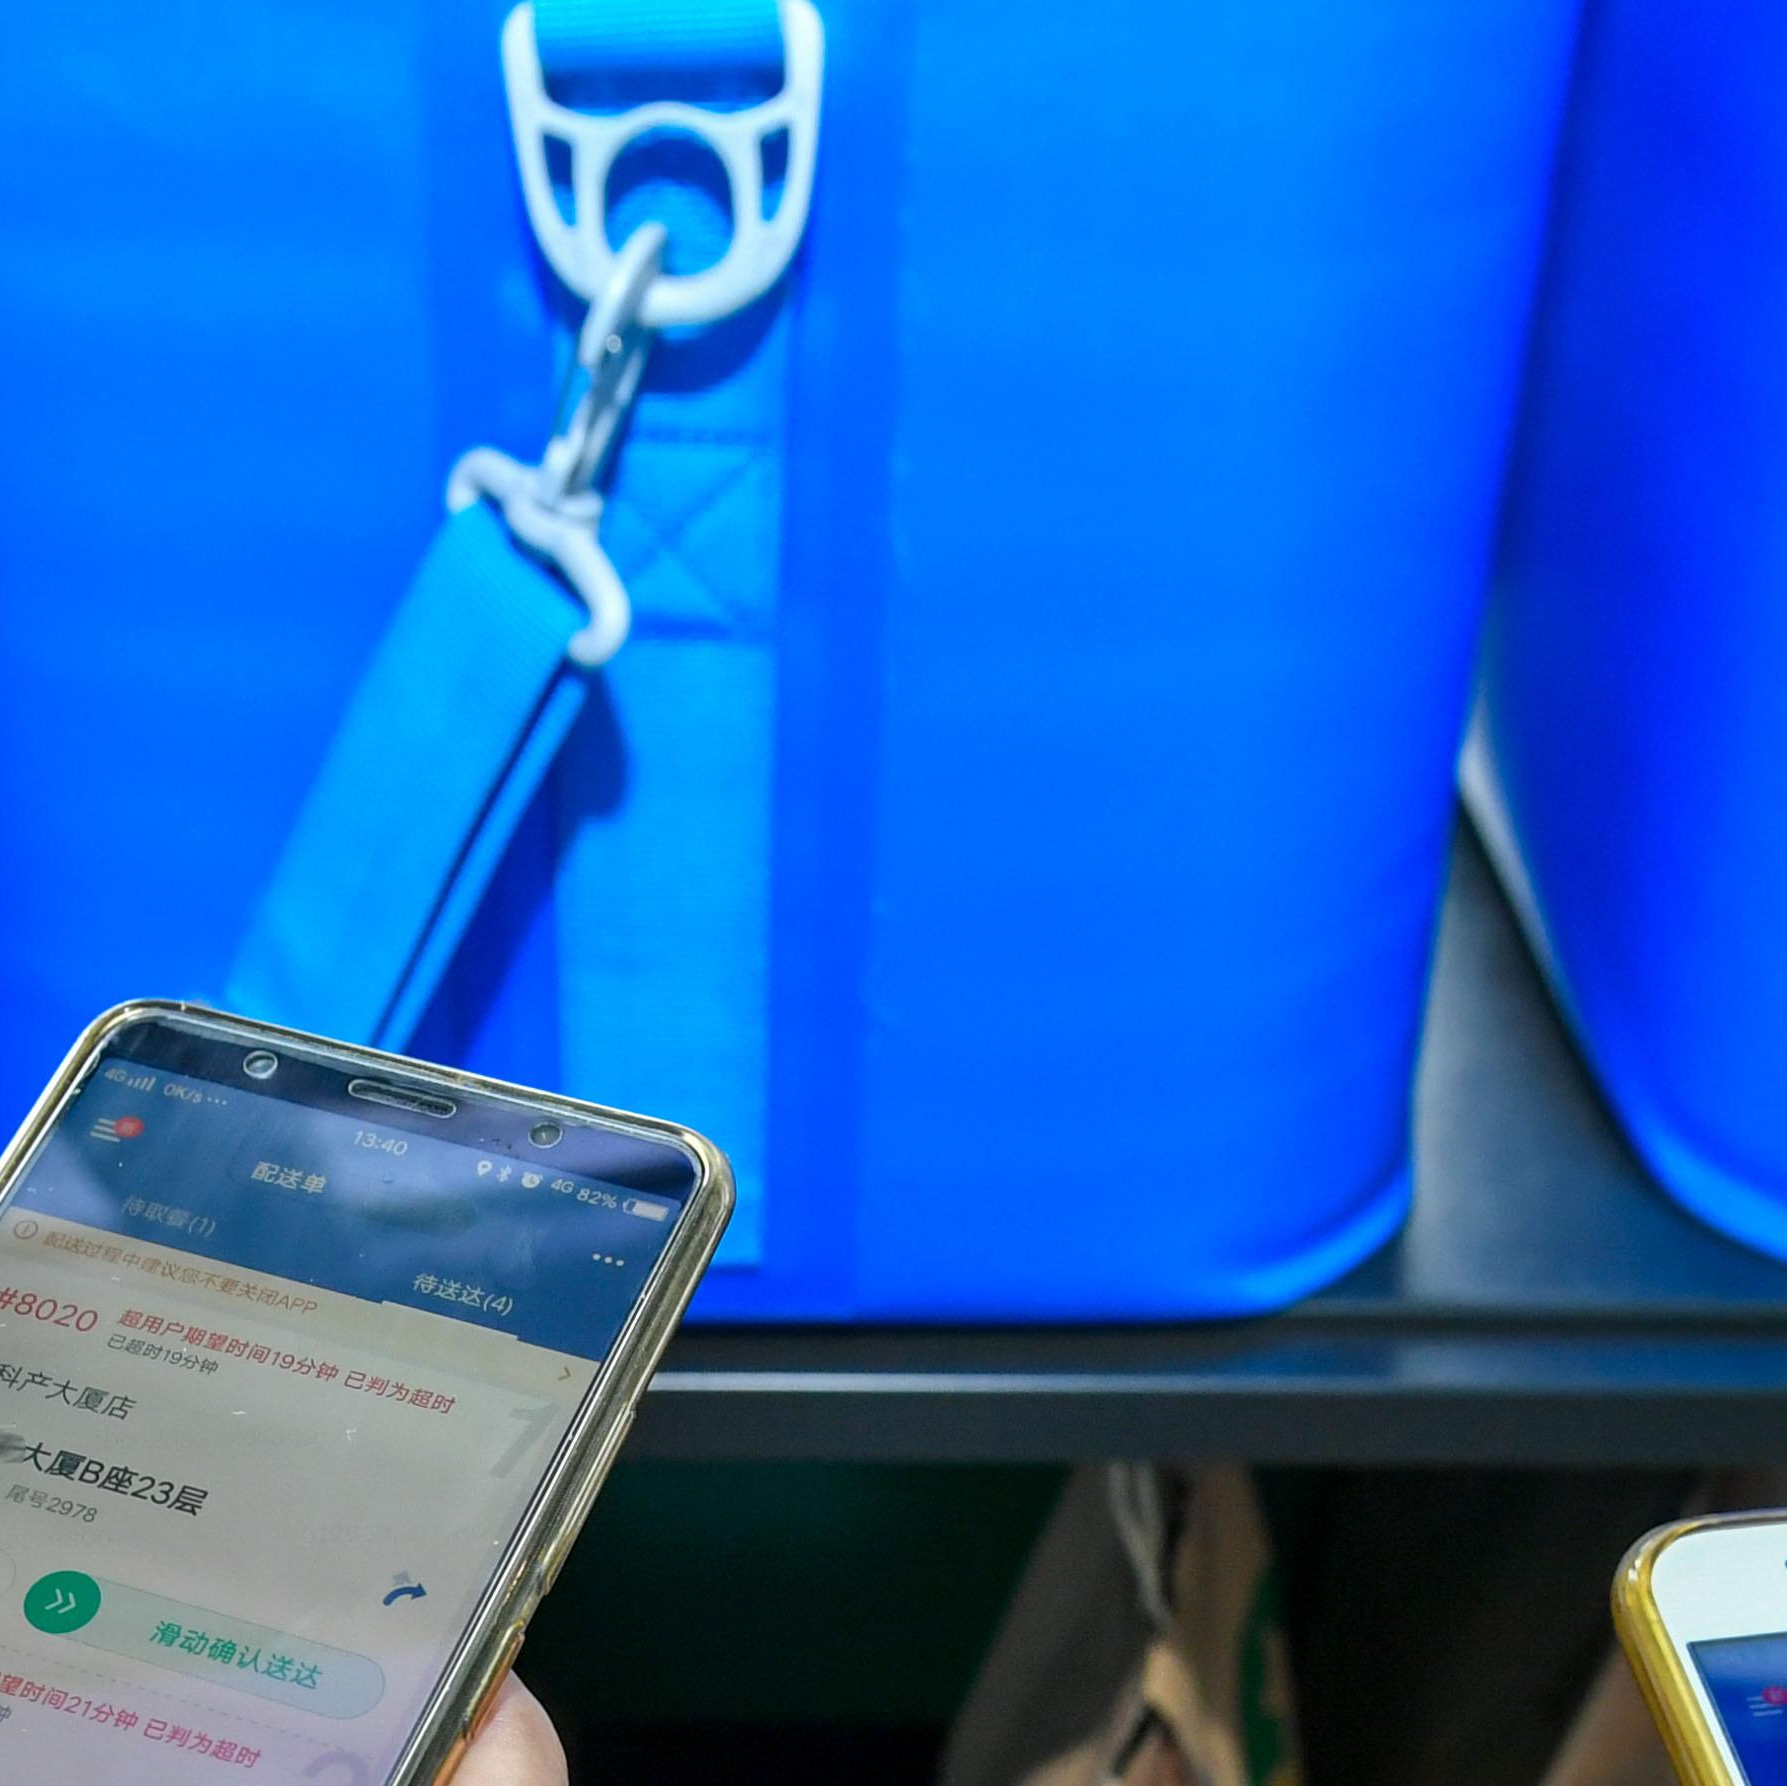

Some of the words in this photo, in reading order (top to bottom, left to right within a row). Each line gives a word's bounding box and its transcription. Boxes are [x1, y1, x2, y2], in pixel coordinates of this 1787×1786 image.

[353, 1129, 408, 1158] 13:40
[249, 1159, 327, 1196] 配送单
[550, 1178, 575, 1196] 4G
[577, 1186, 618, 1210] 82%
[42, 1230, 318, 1316] 配送过程中建议您不要关闭APP
[412, 1271, 515, 1318] 待送达(4)
[106, 1333, 221, 1377] 已超时19分钟
[116, 1308, 341, 1383] 超用户期望时间19分钟
[343, 1369, 457, 1416] 已判为超时
[3, 1483, 99, 1524] 尾号2978
[149, 1619, 324, 1691] 滑动确认送达
[142, 1716, 263, 1770] 已判为超时
